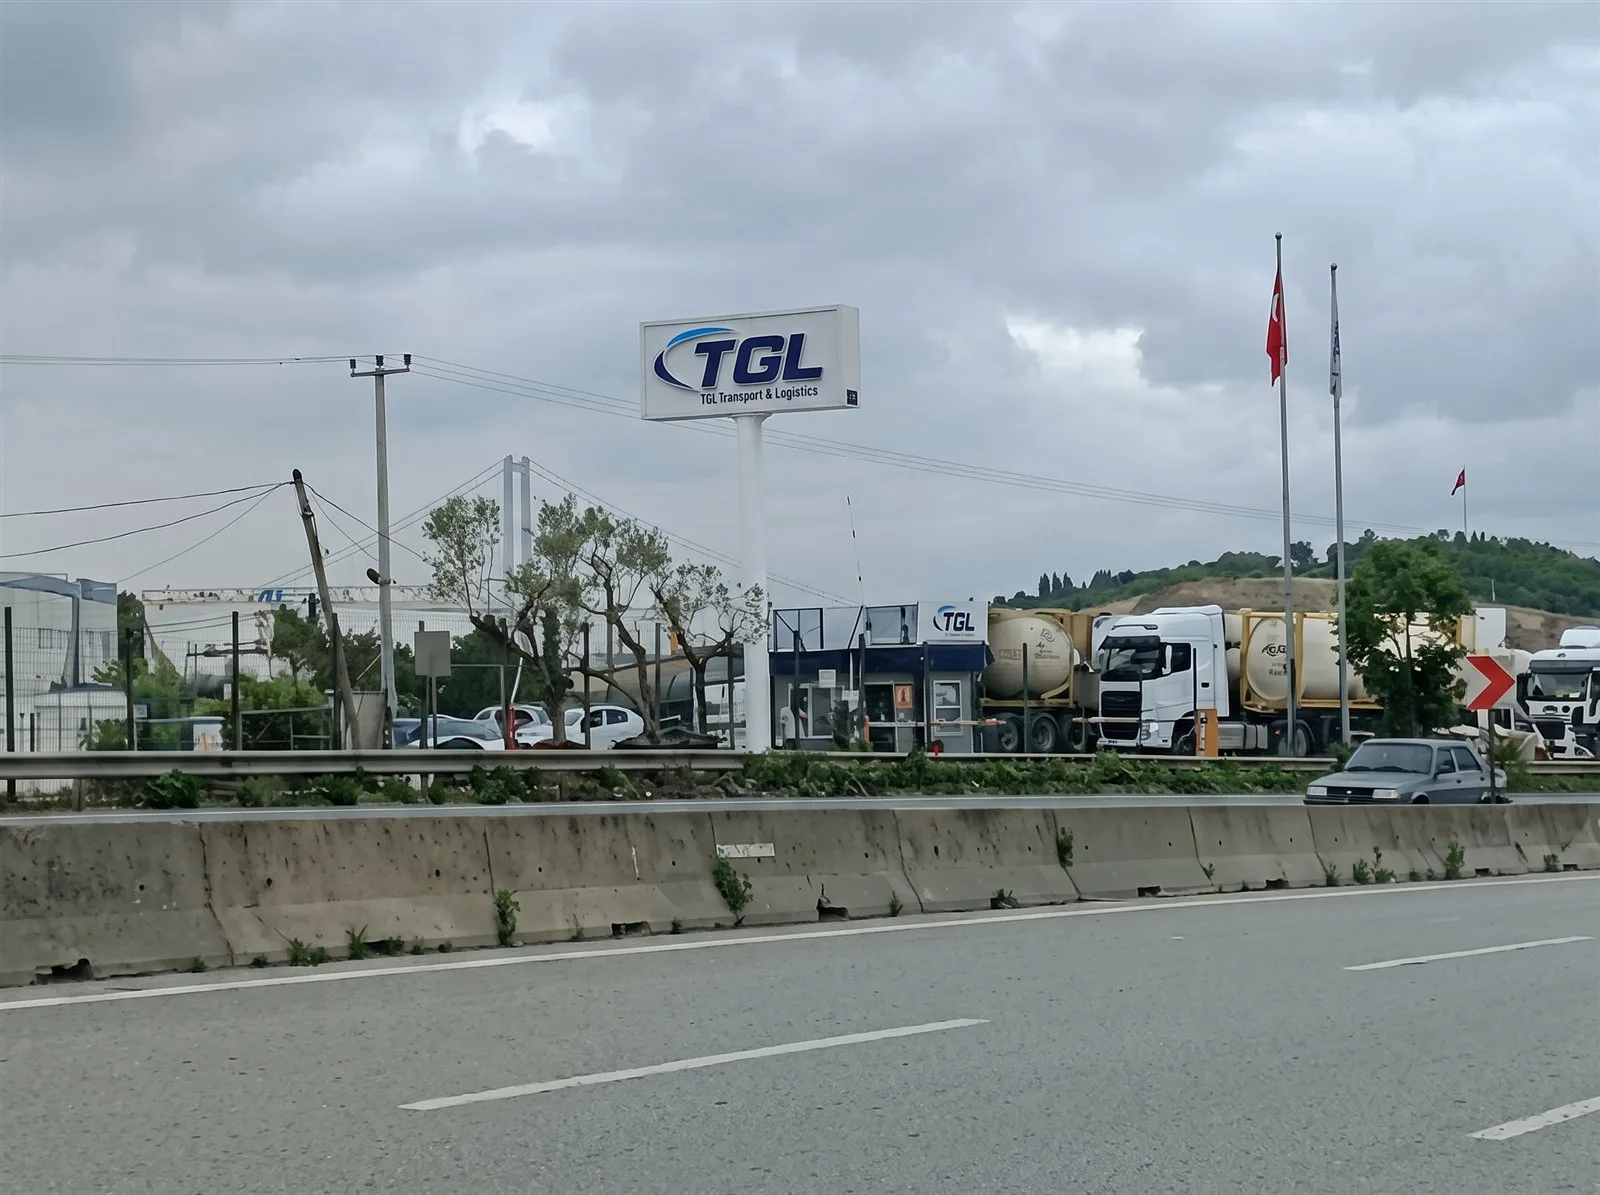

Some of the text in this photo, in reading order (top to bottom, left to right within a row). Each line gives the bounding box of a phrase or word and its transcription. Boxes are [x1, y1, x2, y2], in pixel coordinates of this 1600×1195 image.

[694, 332, 823, 388] TGL
[700, 385, 819, 405] TGL Transport & Logistics
[943, 612, 975, 632] TGL
